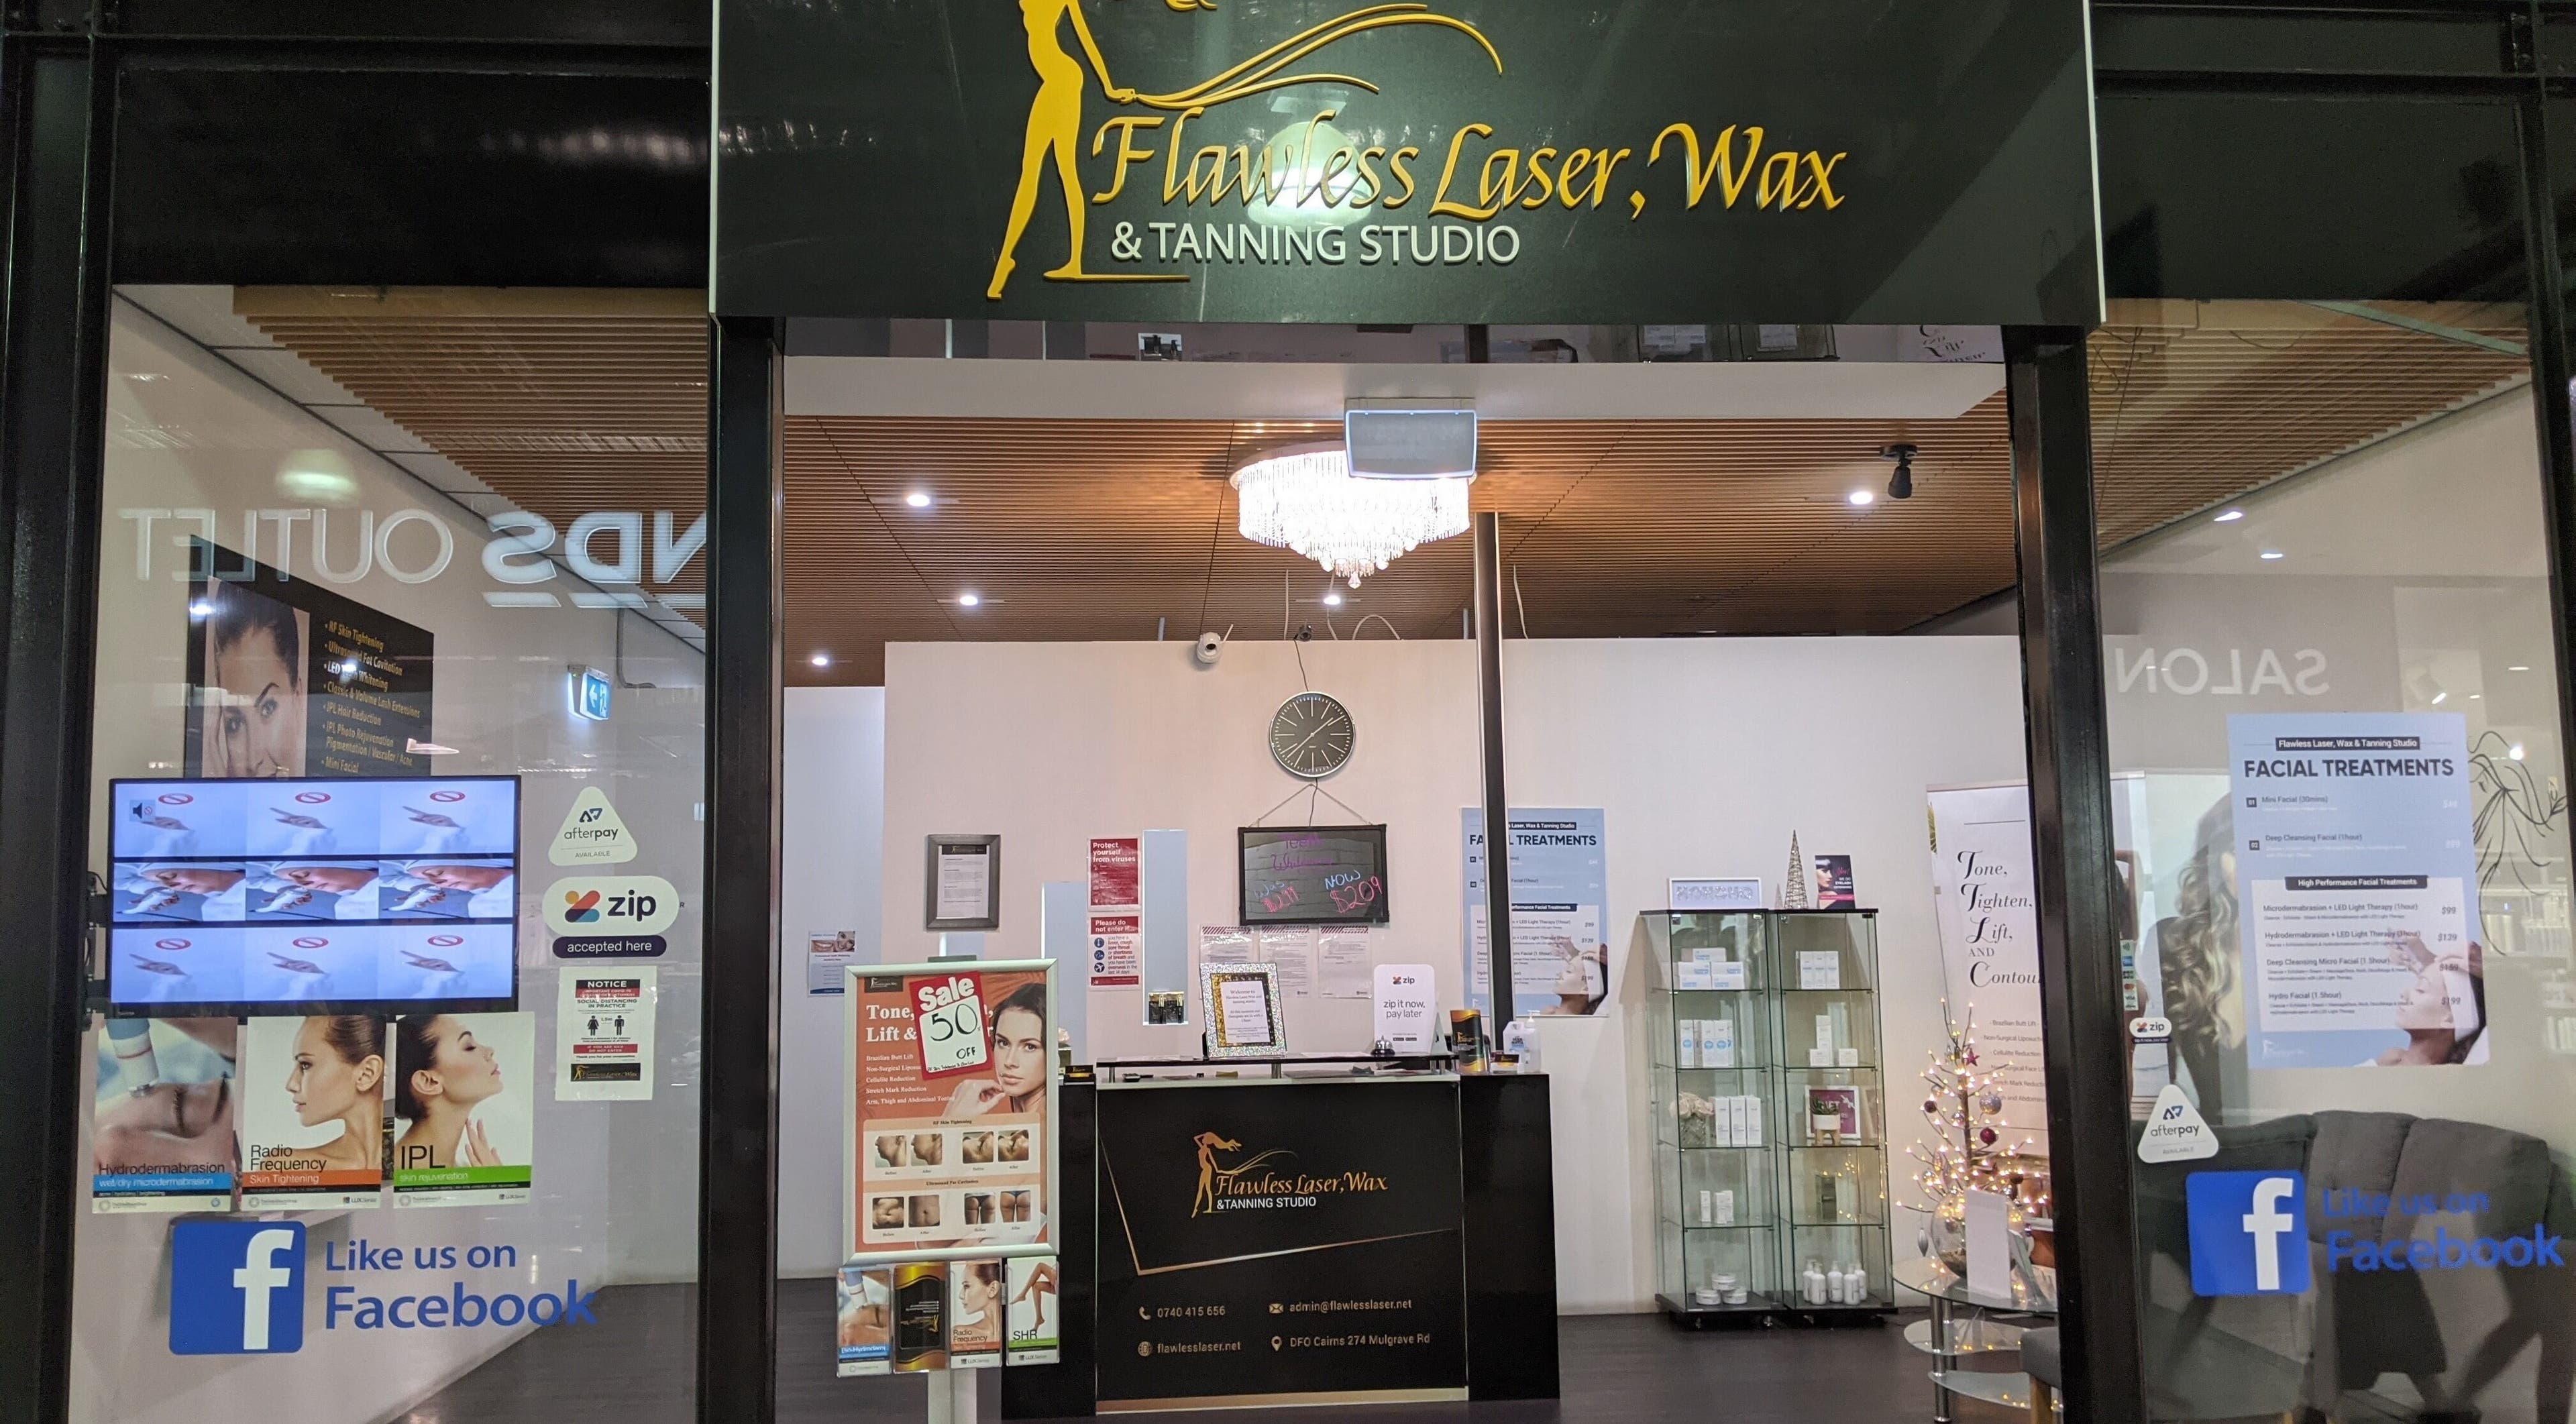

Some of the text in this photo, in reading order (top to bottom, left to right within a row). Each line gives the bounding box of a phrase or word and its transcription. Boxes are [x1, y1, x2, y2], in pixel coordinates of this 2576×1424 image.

[1091, 109, 1419, 208] Flawless
[1648, 122, 1847, 211] Wax
[1111, 221, 1521, 265] & TANNING STUDIO
[337, 622, 384, 653] Skin Tightening
[374, 657, 403, 677] Cavitation
[327, 660, 388, 693] LED Whitening
[327, 681, 349, 698] Classic
[356, 690, 377, 706] Volume
[337, 704, 352, 718] Hair
[352, 709, 382, 726] Reduction
[337, 724, 394, 747] Photo Rejuvenation
[2279, 739, 2311, 748] Flawless
[2336, 739, 2353, 748] Wax
[2354, 739, 2361, 747] &
[2362, 739, 2392, 749] Tanning
[2393, 738, 2418, 747] Studio
[326, 736, 368, 756] Pigmentation
[325, 757, 360, 773] Mini Facial
[2244, 759, 2455, 777] FACIAL TREATMENTS
[564, 827, 619, 841] afterpay
[1516, 834, 1597, 846] TREATMENTS
[1093, 848, 1122, 857] yourself
[1957, 850, 2008, 879] Tone,
[1324, 869, 1361, 890] NOW
[2298, 879, 2314, 887] High
[2380, 877, 2418, 885] Treatments
[1330, 875, 1383, 914] $209
[607, 889, 657, 922] zip
[2367, 903, 2393, 912] Therapy
[1965, 916, 2013, 944] Lift,
[567, 940, 652, 954] accepted here
[1968, 947, 1995, 957] AND
[1402, 976, 1415, 985] zip
[1970, 961, 2041, 987] Contou
[587, 980, 627, 989] NOTICE
[917, 976, 975, 1011] Sale
[1383, 999, 1426, 1009] zip it now,
[865, 1004, 915, 1022] Tone,
[1385, 1009, 1423, 1020] pay later
[865, 1026, 918, 1043] Lift &
[2149, 1022, 2165, 1032] zip
[956, 1046, 976, 1060] OFF
[2150, 1124, 2200, 1138] afterpay
[250, 1144, 293, 1158] Radio
[400, 1144, 446, 1170] IPL
[99, 1162, 226, 1177] Hydrodermabrasion
[250, 1158, 327, 1173] Frequency
[250, 1174, 319, 1185] Skin Tightening
[399, 1172, 468, 1184] skin rejuvenation
[1215, 1171, 1293, 1196] Flawless
[1343, 1170, 1389, 1193] Wax
[1275, 1196, 1317, 1208] STUDIO
[2322, 1186, 2489, 1217] Like us on
[326, 1239, 517, 1271] Like us on
[2326, 1222, 2566, 1274] Facebook
[325, 1279, 597, 1330] Facebook
[1157, 1305, 1226, 1319] 0740 415 656
[1289, 1299, 1412, 1315] admin@flawlesslaser.net
[1012, 1329, 1038, 1341] SHR
[1289, 1332, 1431, 1348] DFO Cairns 274 Mulgrave Rd
[1157, 1341, 1242, 1354] flawlesslaser.net
